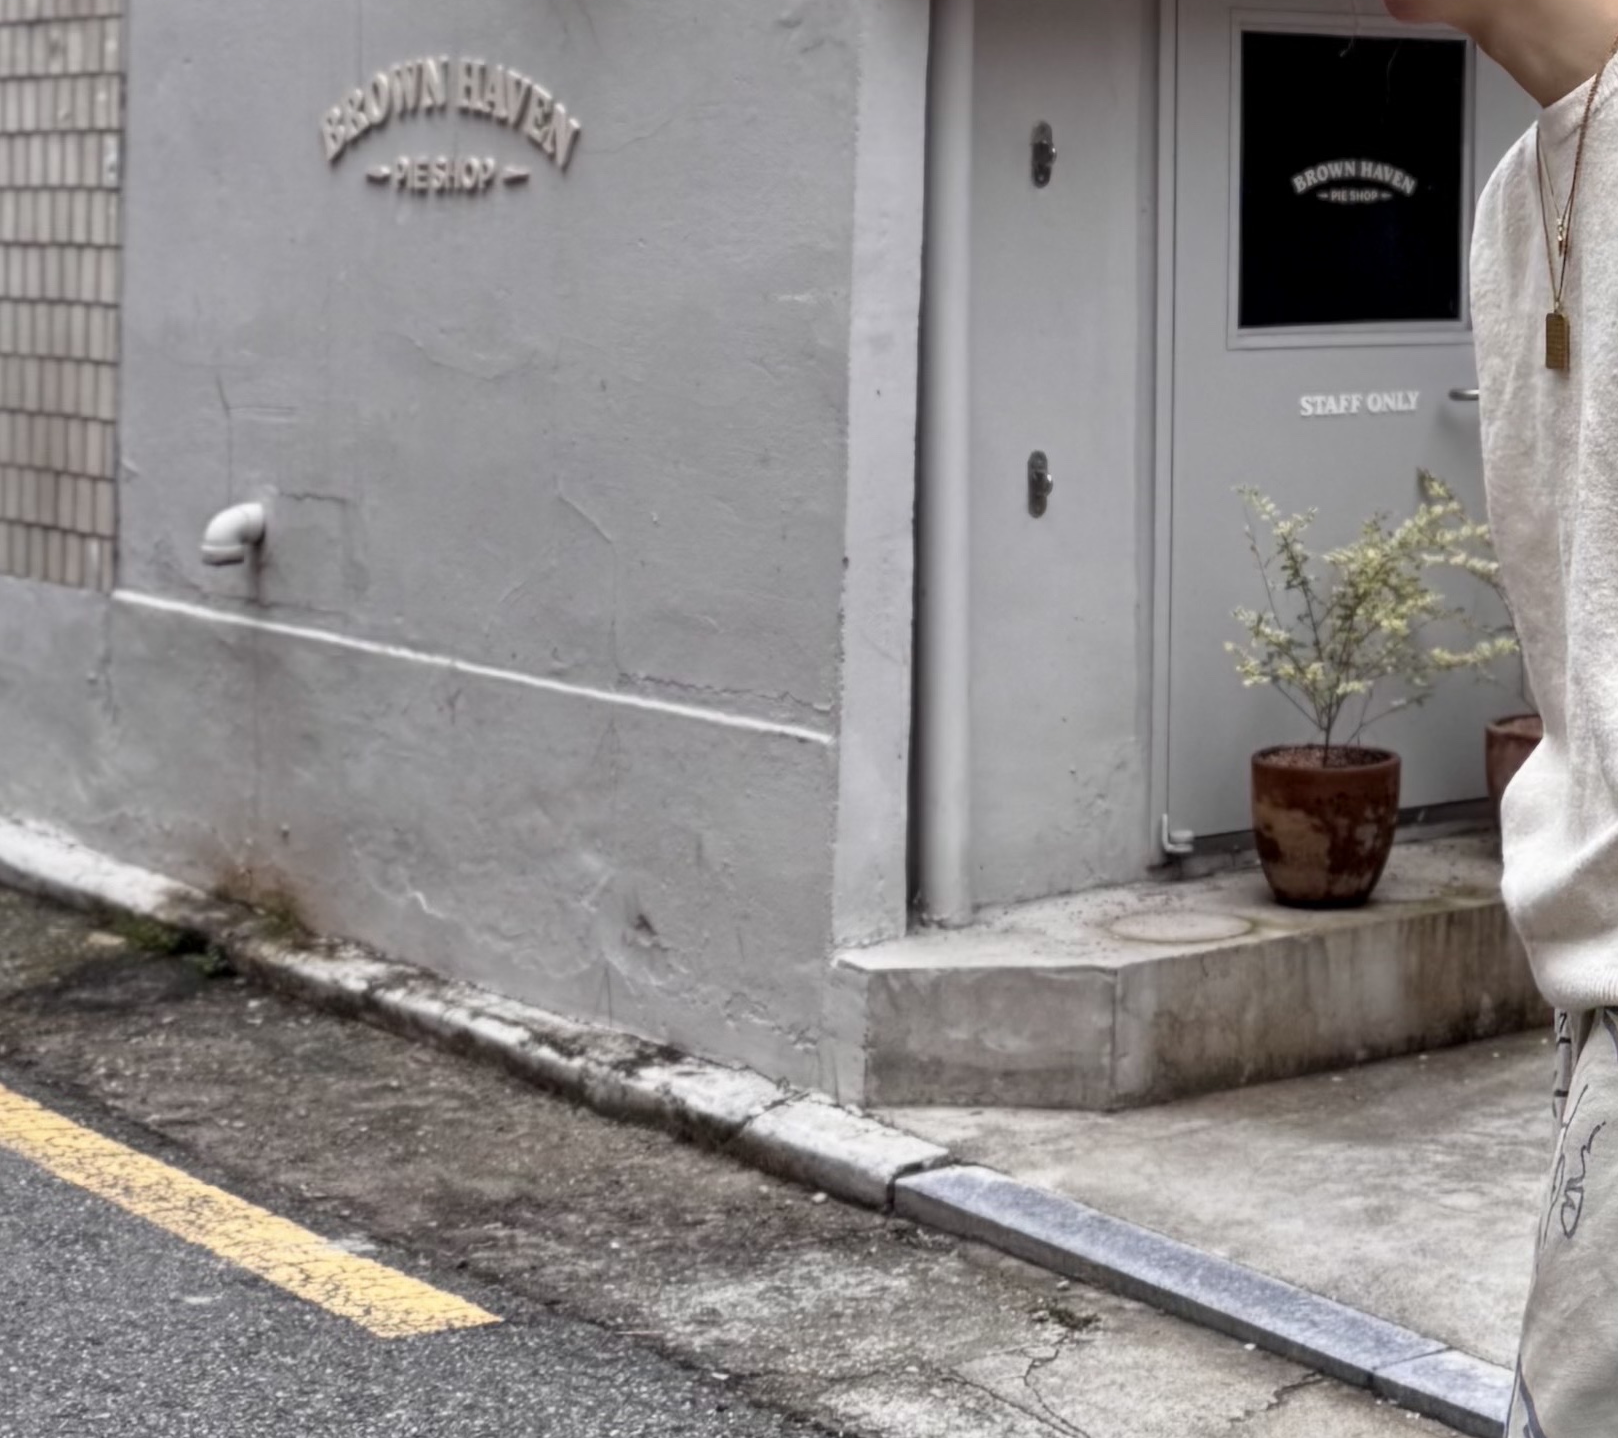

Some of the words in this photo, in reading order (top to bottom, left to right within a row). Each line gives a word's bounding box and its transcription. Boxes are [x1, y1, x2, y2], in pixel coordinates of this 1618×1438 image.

[322, 58, 449, 165] BROWN
[457, 57, 580, 169] HAVEN
[1293, 160, 1356, 193] BROWN
[1360, 161, 1415, 194] HAVEN
[1330, 190, 1348, 202] PIE
[1349, 190, 1378, 202] SHOP
[1299, 394, 1363, 416] STAFF
[1367, 391, 1420, 412] ONLY
